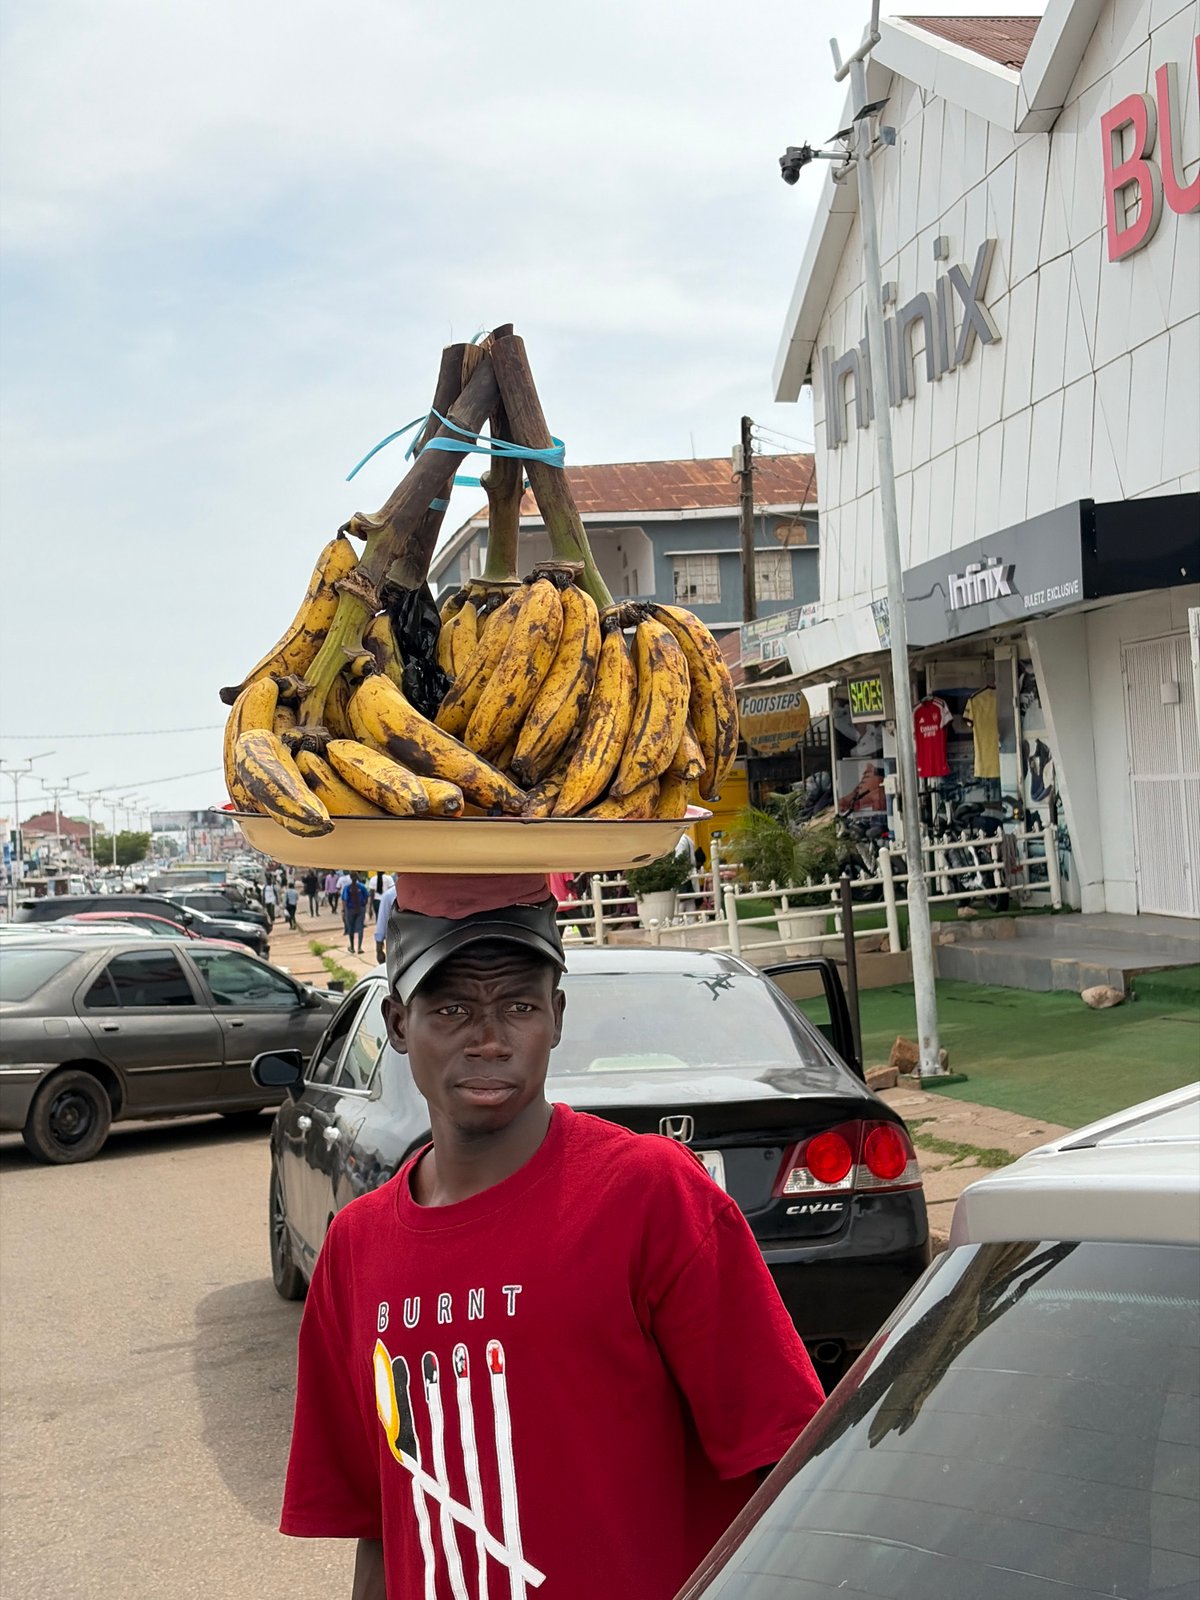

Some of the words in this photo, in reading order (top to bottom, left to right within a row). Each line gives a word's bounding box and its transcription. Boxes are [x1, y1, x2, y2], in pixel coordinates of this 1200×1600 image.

[822, 236, 1001, 449] Ininix
[948, 557, 1012, 610] Infinix
[1046, 579, 1079, 601] EXCLUSIVE
[742, 692, 802, 716] FOOTSTEPS
[850, 678, 883, 713] SHOES
[786, 1202, 843, 1215] CIVIC
[377, 1284, 522, 1332] BURNT
